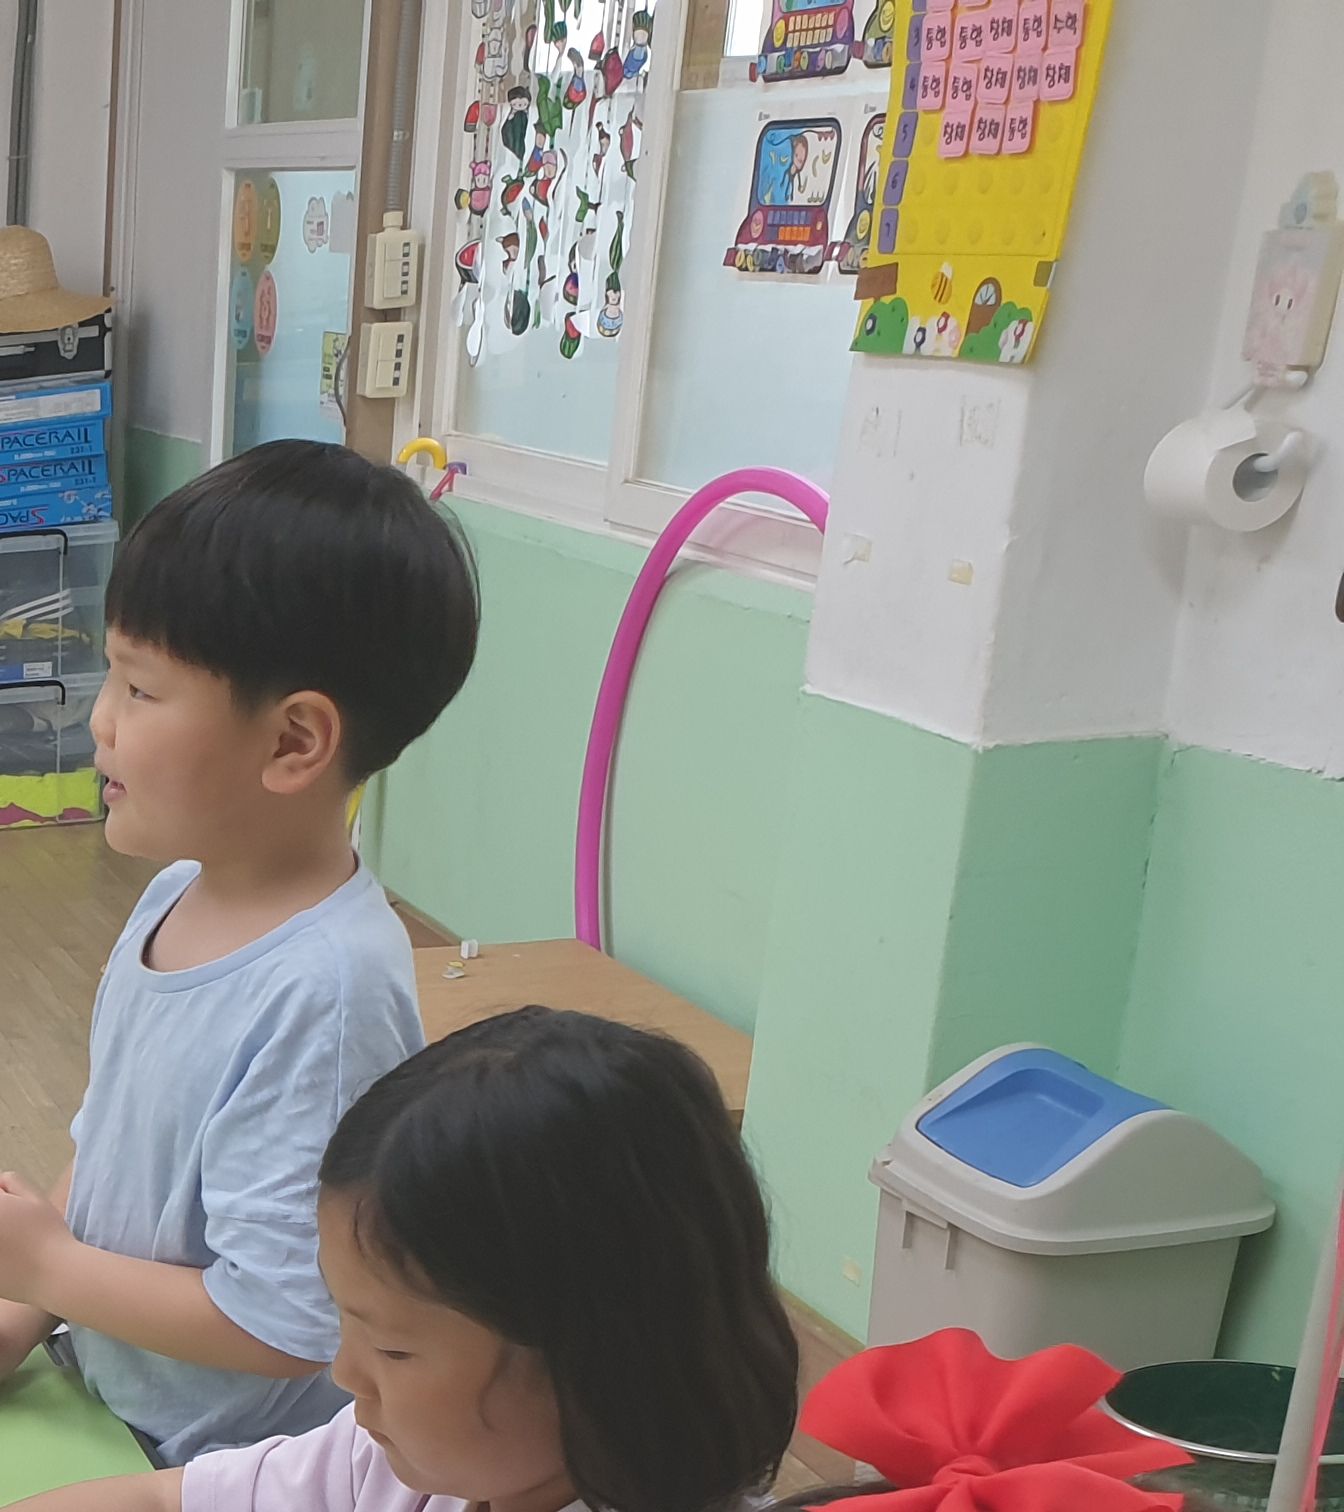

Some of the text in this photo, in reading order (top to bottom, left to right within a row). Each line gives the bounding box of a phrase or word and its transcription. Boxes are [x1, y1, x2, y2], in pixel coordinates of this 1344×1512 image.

[926, 25, 946, 50] 통합
[959, 24, 982, 49] 통합
[990, 16, 1013, 41] 창체
[1022, 15, 1043, 41] 통합
[921, 74, 941, 99] 통합
[952, 76, 972, 101] 통합
[983, 65, 1007, 89] 창체
[1045, 63, 1071, 88] 창체
[1008, 116, 1029, 142] 통합
